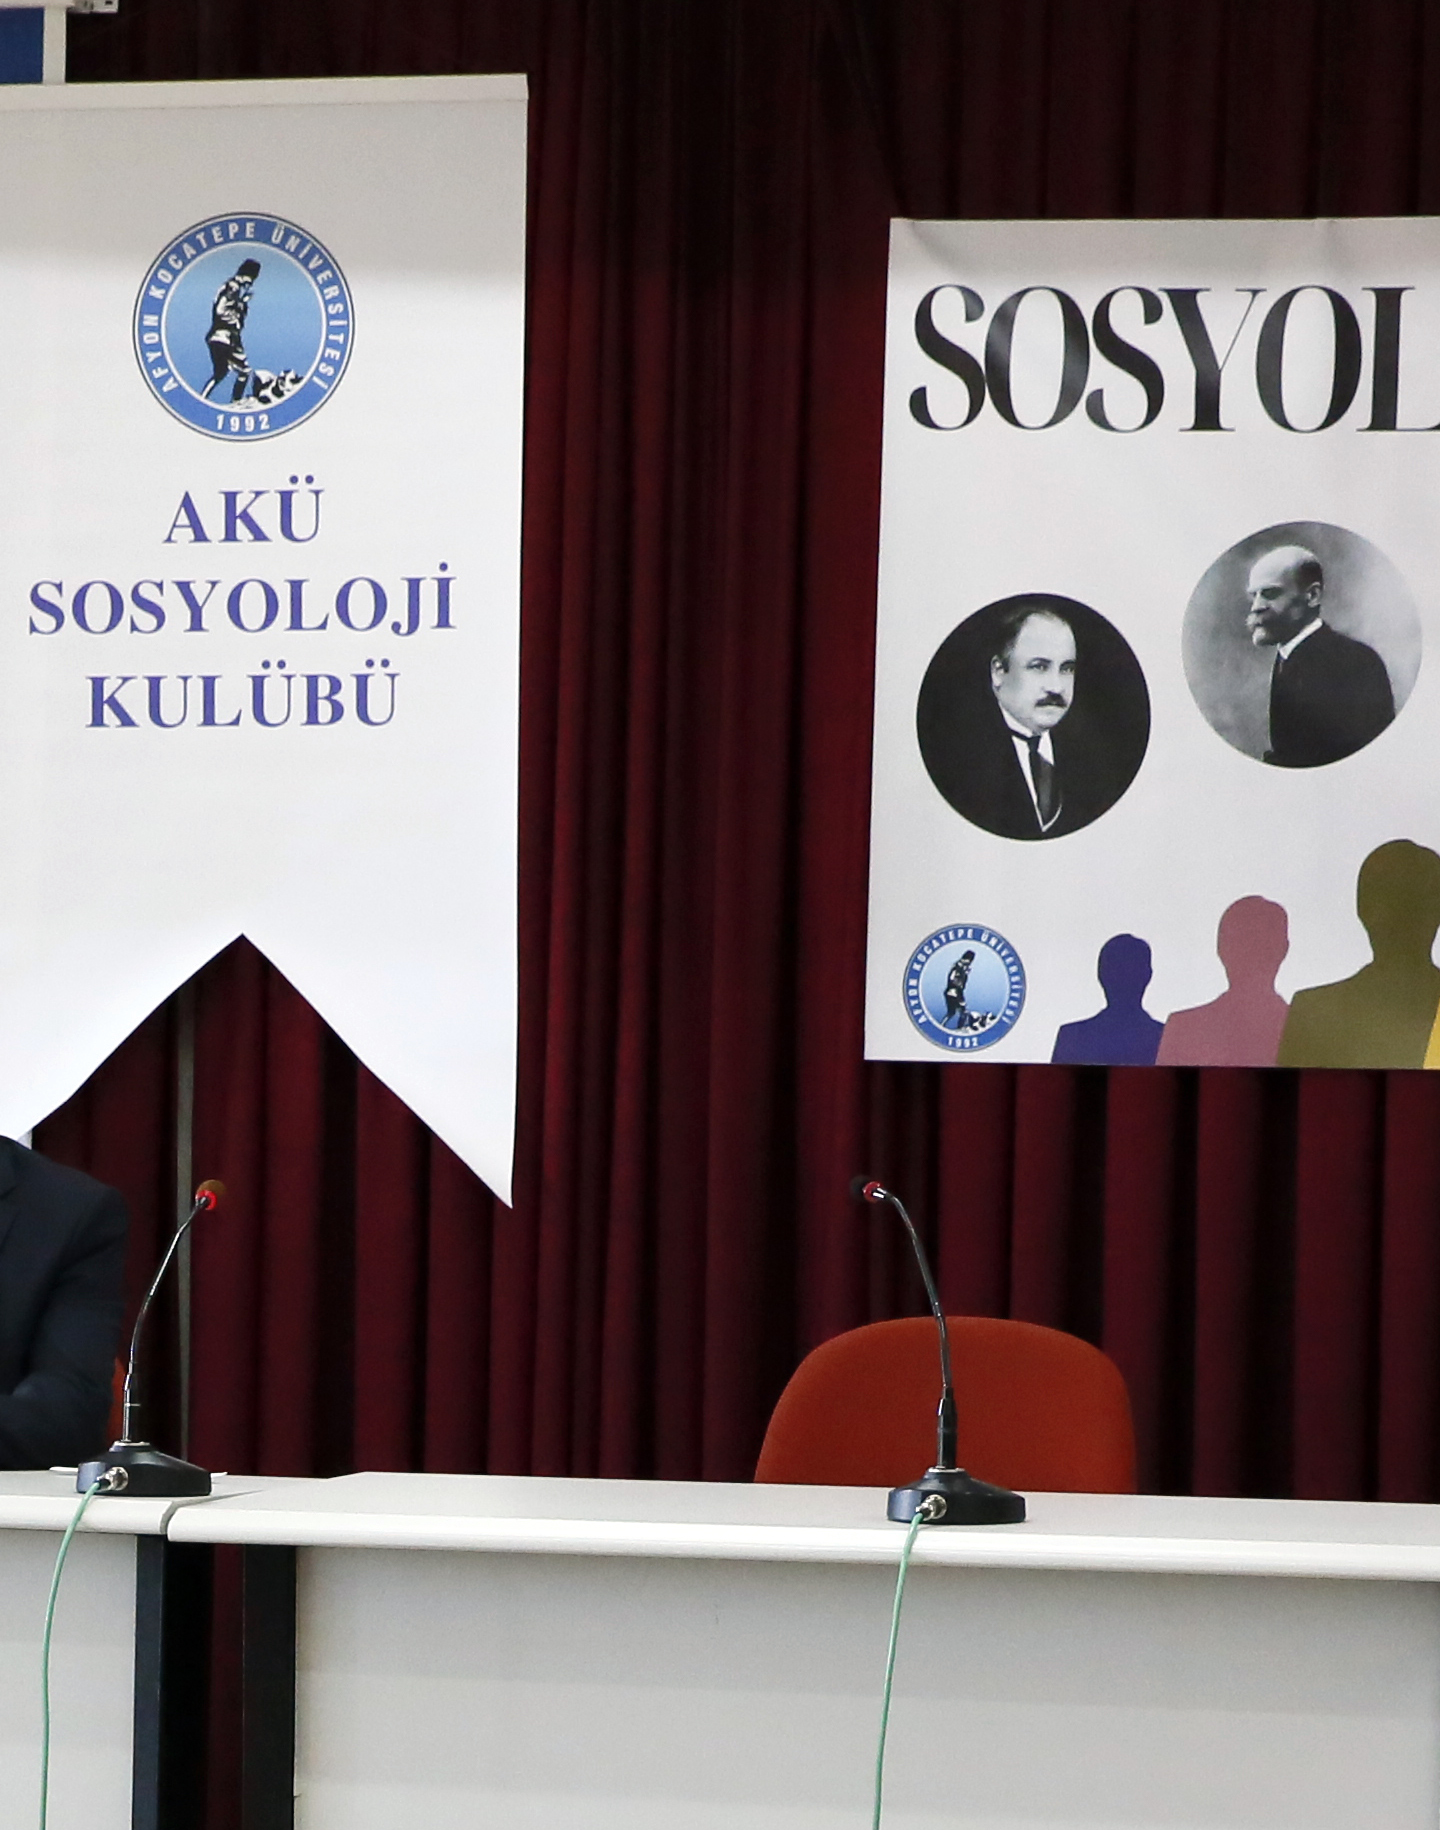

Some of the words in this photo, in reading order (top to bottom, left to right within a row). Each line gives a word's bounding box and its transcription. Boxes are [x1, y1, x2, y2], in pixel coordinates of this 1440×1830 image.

[149, 222, 255, 300] KOCATEPE
[143, 314, 178, 393] AFYON
[217, 414, 270, 432] 1992
[162, 475, 324, 543] AKÜ
[29, 562, 457, 636] SOSYOLOJİ
[85, 659, 400, 727] KULÜBÜ
[912, 929, 973, 972] KOCATEPE
[908, 979, 927, 1024] AFYON
[948, 1037, 978, 1048] 1992
